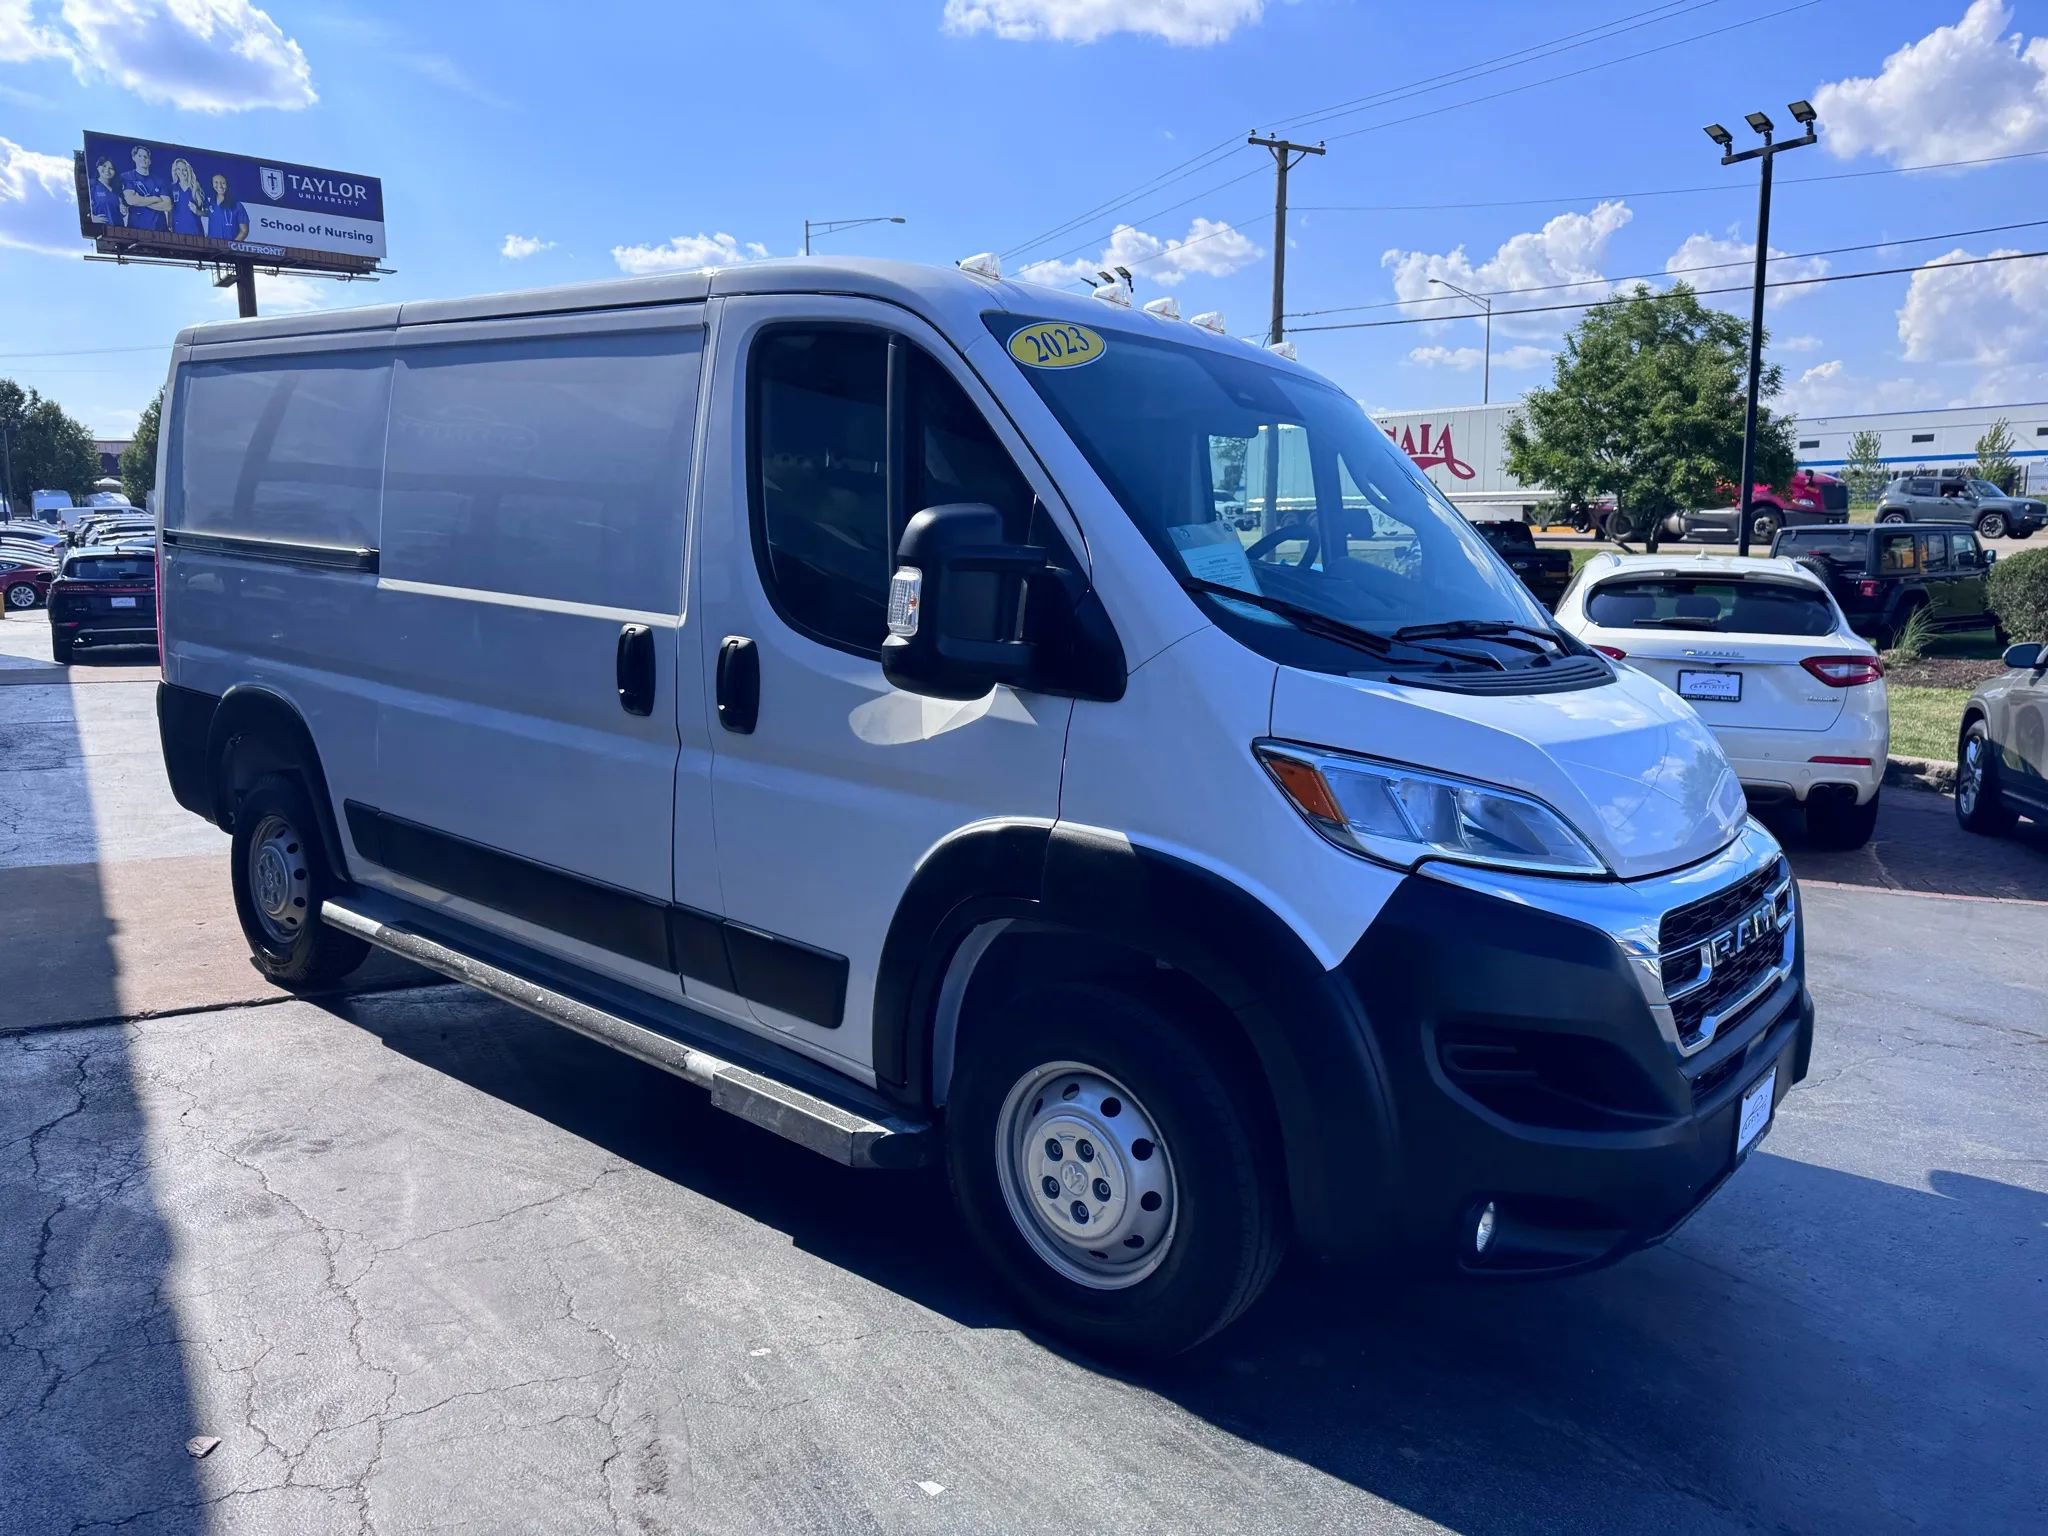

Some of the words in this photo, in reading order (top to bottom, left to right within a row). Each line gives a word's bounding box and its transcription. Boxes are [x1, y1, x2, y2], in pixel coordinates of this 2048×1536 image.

[287, 174, 368, 200] TAYLOR
[298, 192, 360, 207] UNIVERSITY
[260, 217, 305, 233] School
[308, 225, 322, 235] of
[324, 227, 374, 244] Nursing
[1025, 326, 1090, 363] 2023
[1711, 903, 1777, 967] RAM
